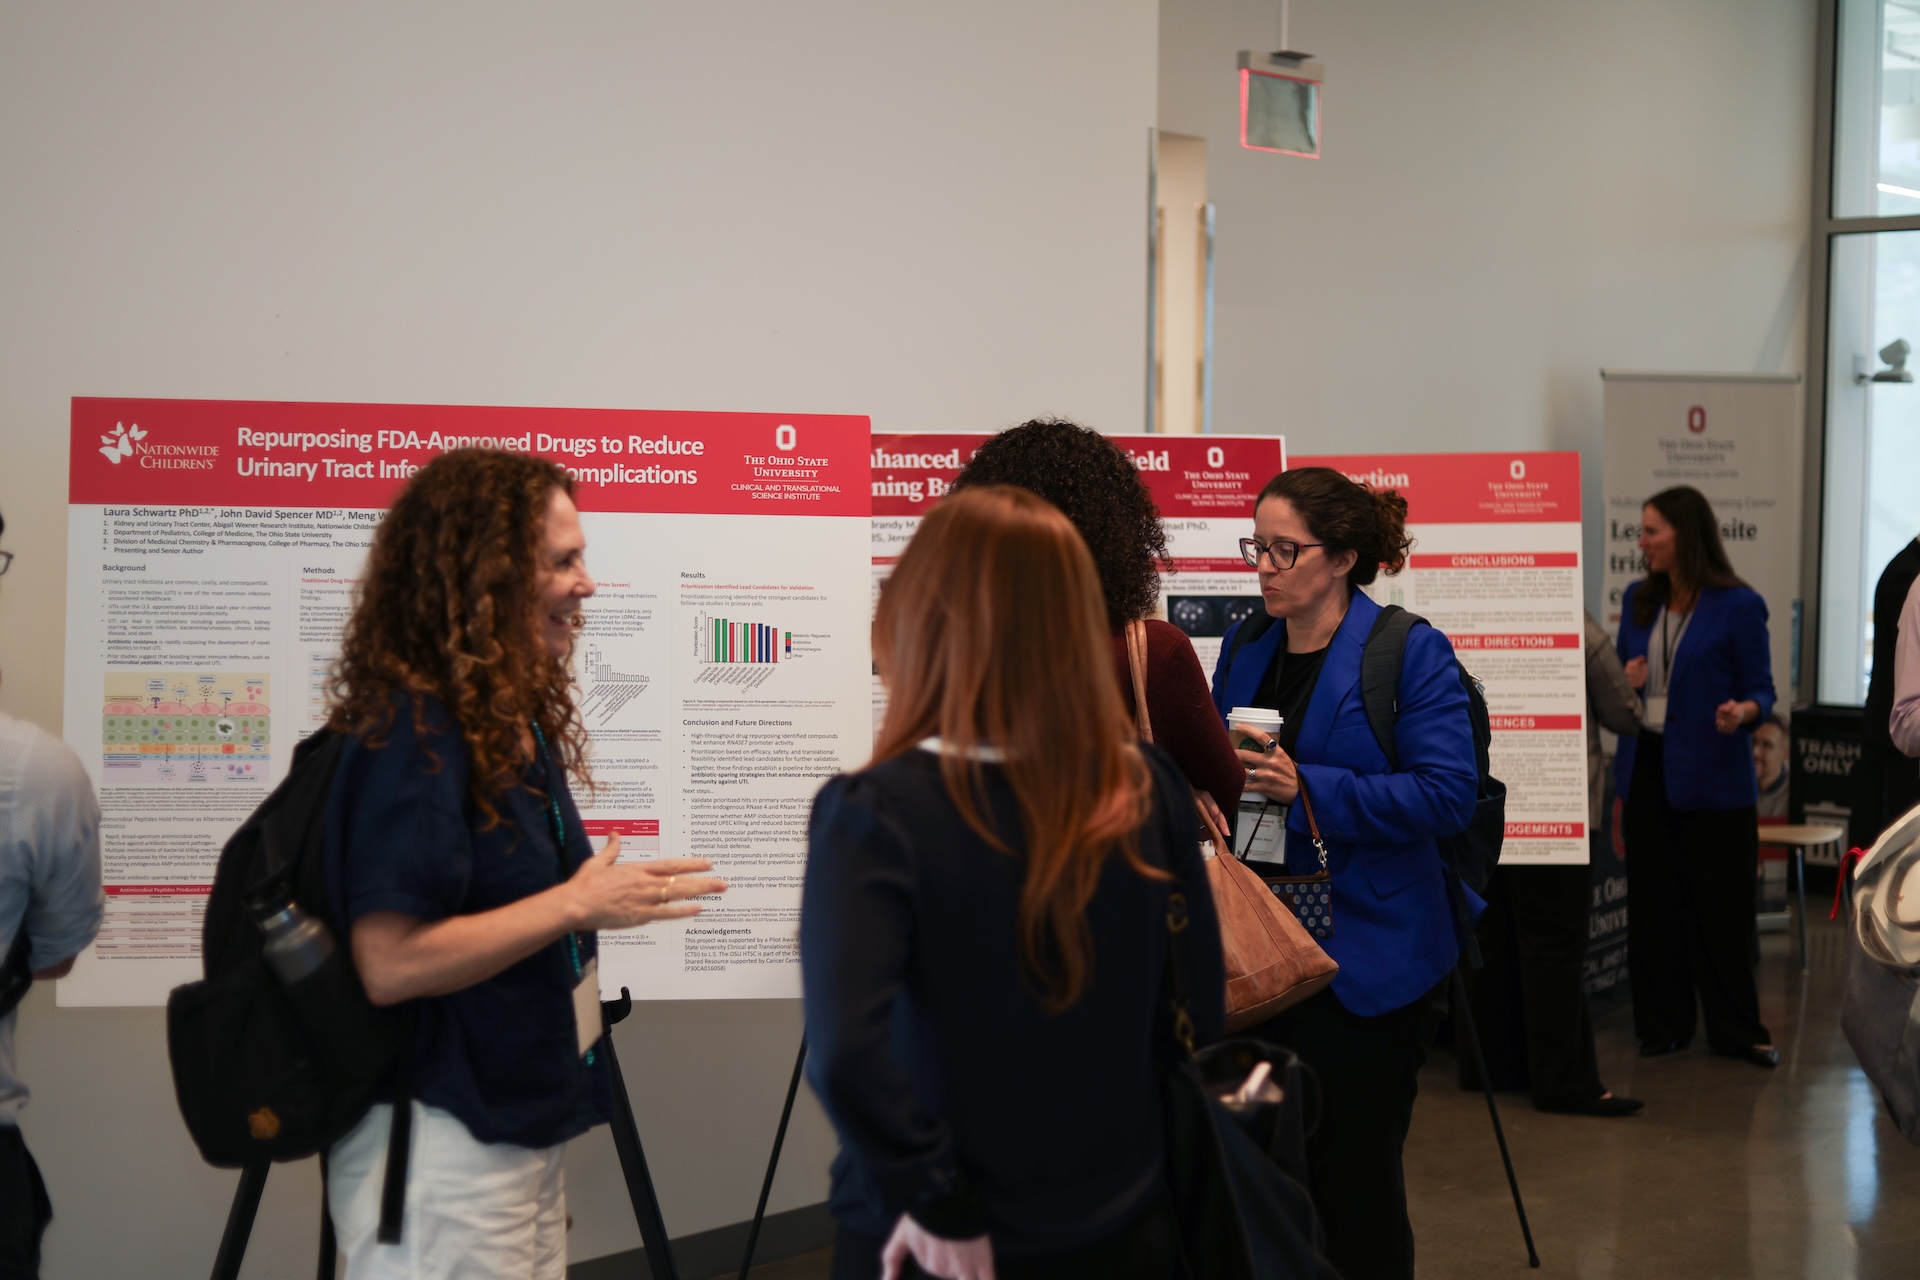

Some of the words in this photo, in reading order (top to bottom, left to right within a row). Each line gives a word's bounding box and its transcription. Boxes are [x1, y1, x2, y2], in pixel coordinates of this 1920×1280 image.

[237, 427, 373, 453] Repurposing
[377, 430, 531, 454] FDA-Approved
[537, 433, 597, 458] Drugs
[601, 436, 623, 454] to
[628, 434, 705, 456] Reduce
[775, 424, 797, 451] O
[135, 442, 219, 456] NATIONWIDE
[140, 455, 214, 470] CHILDREN'S
[743, 455, 766, 465] THE
[768, 455, 795, 466] OHIO
[797, 456, 829, 467] STATE
[1207, 447, 1224, 468] O
[237, 457, 318, 482] Urinary
[322, 458, 374, 479] Tract
[753, 467, 819, 478] UNIVERSITY
[1183, 471, 1201, 480] THE
[1202, 471, 1224, 480] OHIO
[1225, 471, 1250, 480] STATE
[1510, 460, 1526, 480] O
[765, 484, 781, 492] AND
[783, 484, 841, 492] TRANSLATIONAL
[1191, 481, 1243, 490] UNIVERSITY
[752, 492, 783, 500] SCIENCE
[103, 508, 130, 516] Laura
[132, 508, 176, 517] Schwartz
[220, 510, 242, 518] John
[244, 510, 272, 518] David
[274, 510, 312, 521] Spencer
[348, 512, 375, 521] Meng
[1451, 555, 1535, 567] CONCLUSIONS
[1484, 636, 1554, 648] DIRECTIONS
[1797, 738, 1861, 760] TRASH
[1803, 755, 1854, 776] ONLY
